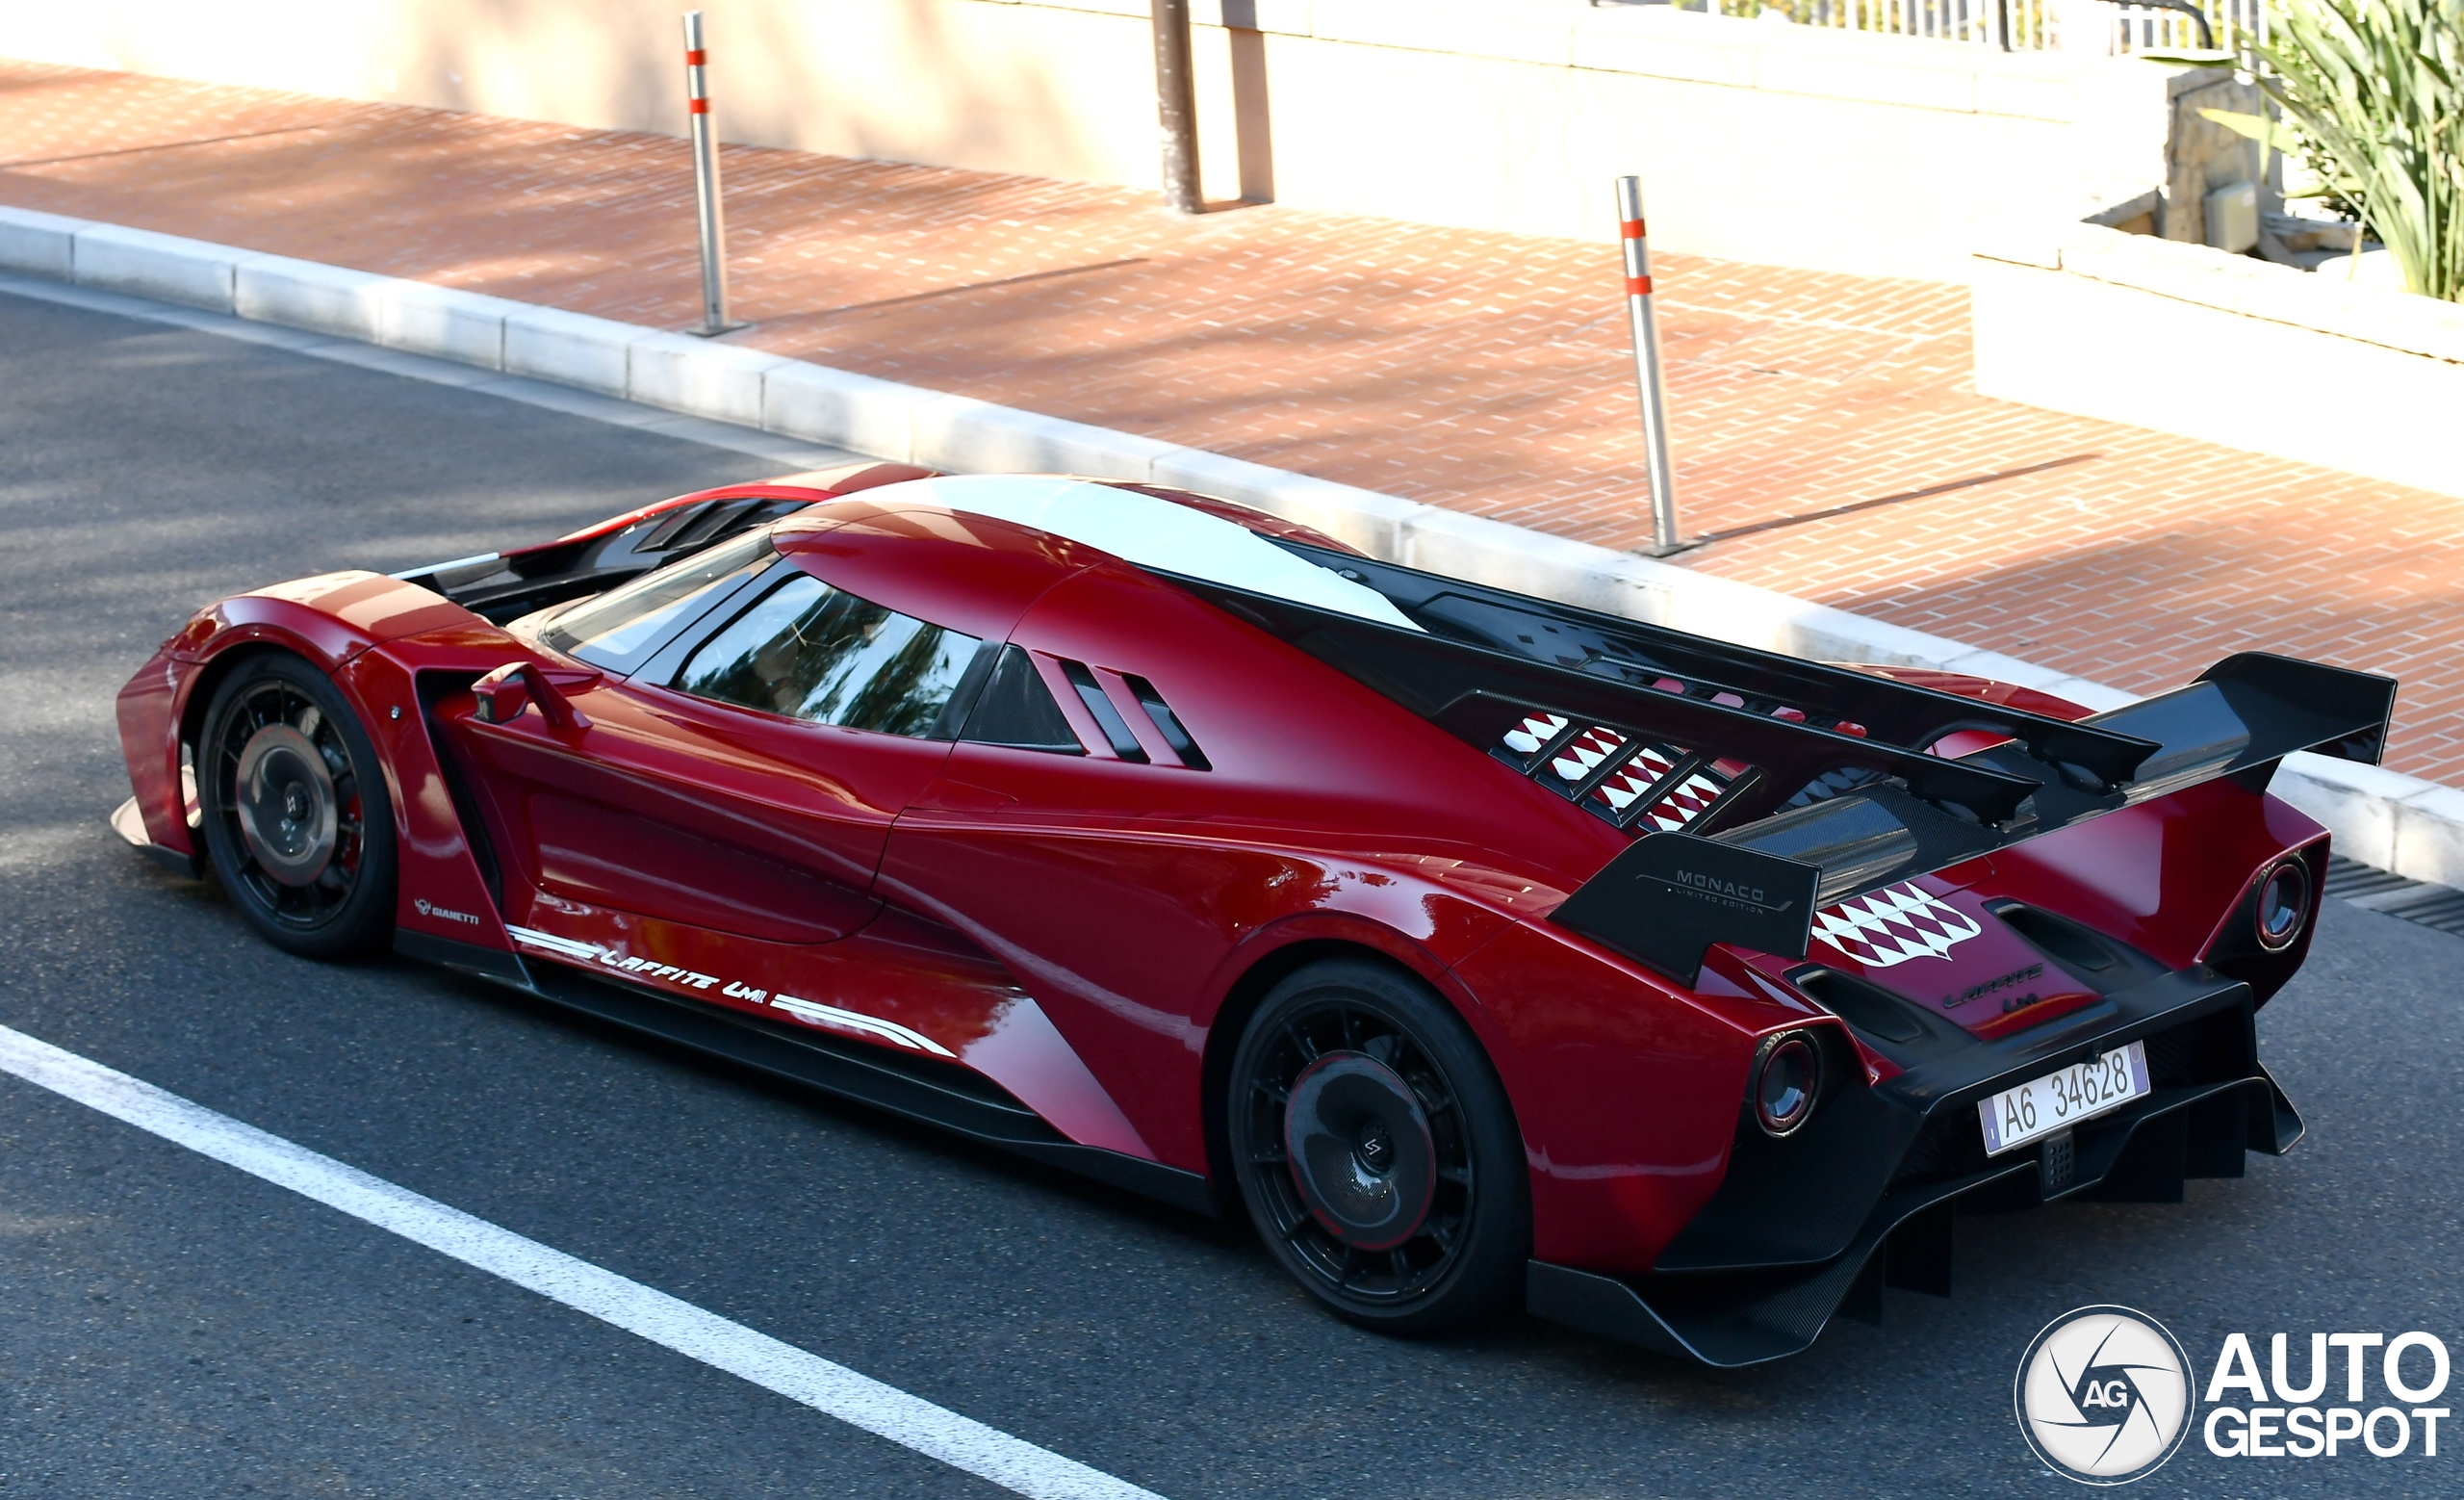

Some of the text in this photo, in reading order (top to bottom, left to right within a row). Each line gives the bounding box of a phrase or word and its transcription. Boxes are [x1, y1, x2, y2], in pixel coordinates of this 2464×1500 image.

[1676, 888, 1764, 915] LIMITED EDITION
[1677, 869, 1764, 902] MONACO
[432, 907, 479, 925] GIANETTI
[600, 950, 720, 990] LAFFITE
[2005, 1052, 2129, 1138] A6 34628
